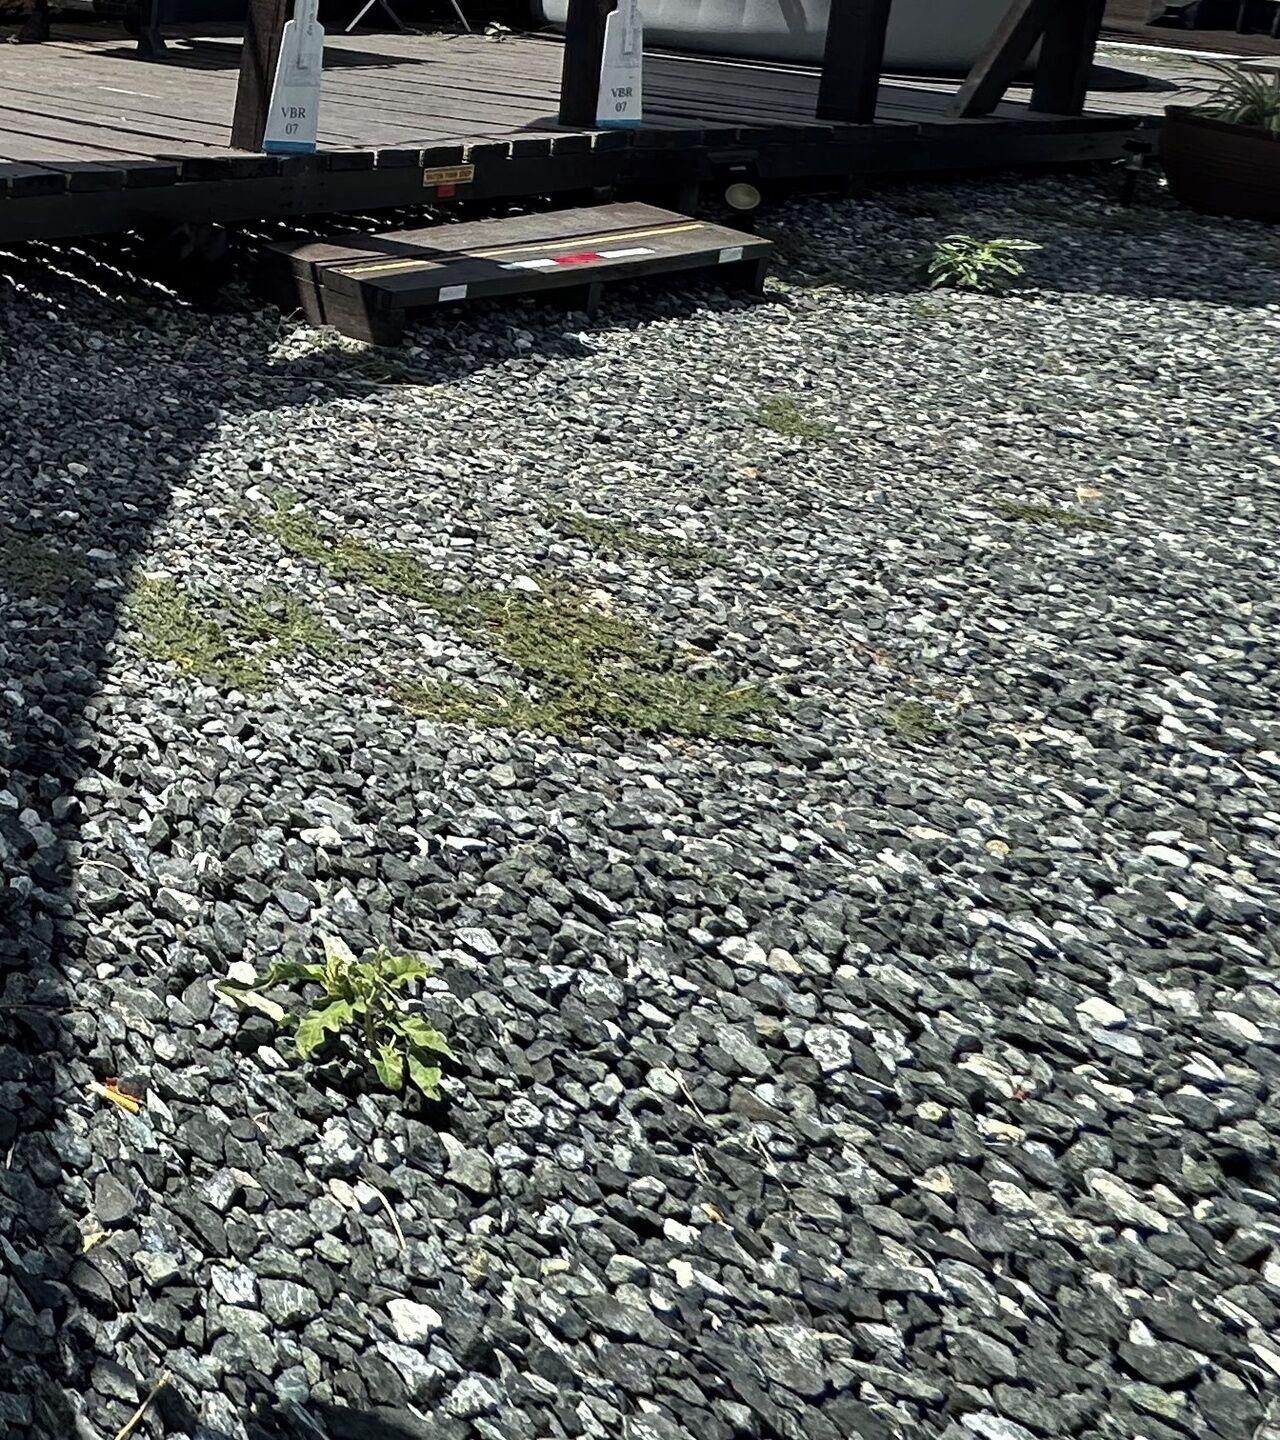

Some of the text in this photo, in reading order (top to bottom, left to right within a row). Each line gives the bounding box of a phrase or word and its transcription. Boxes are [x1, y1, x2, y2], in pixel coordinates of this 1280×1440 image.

[611, 86, 633, 98] VBR
[281, 106, 306, 119] VBR
[615, 101, 627, 112] 07
[285, 123, 299, 135] 07
